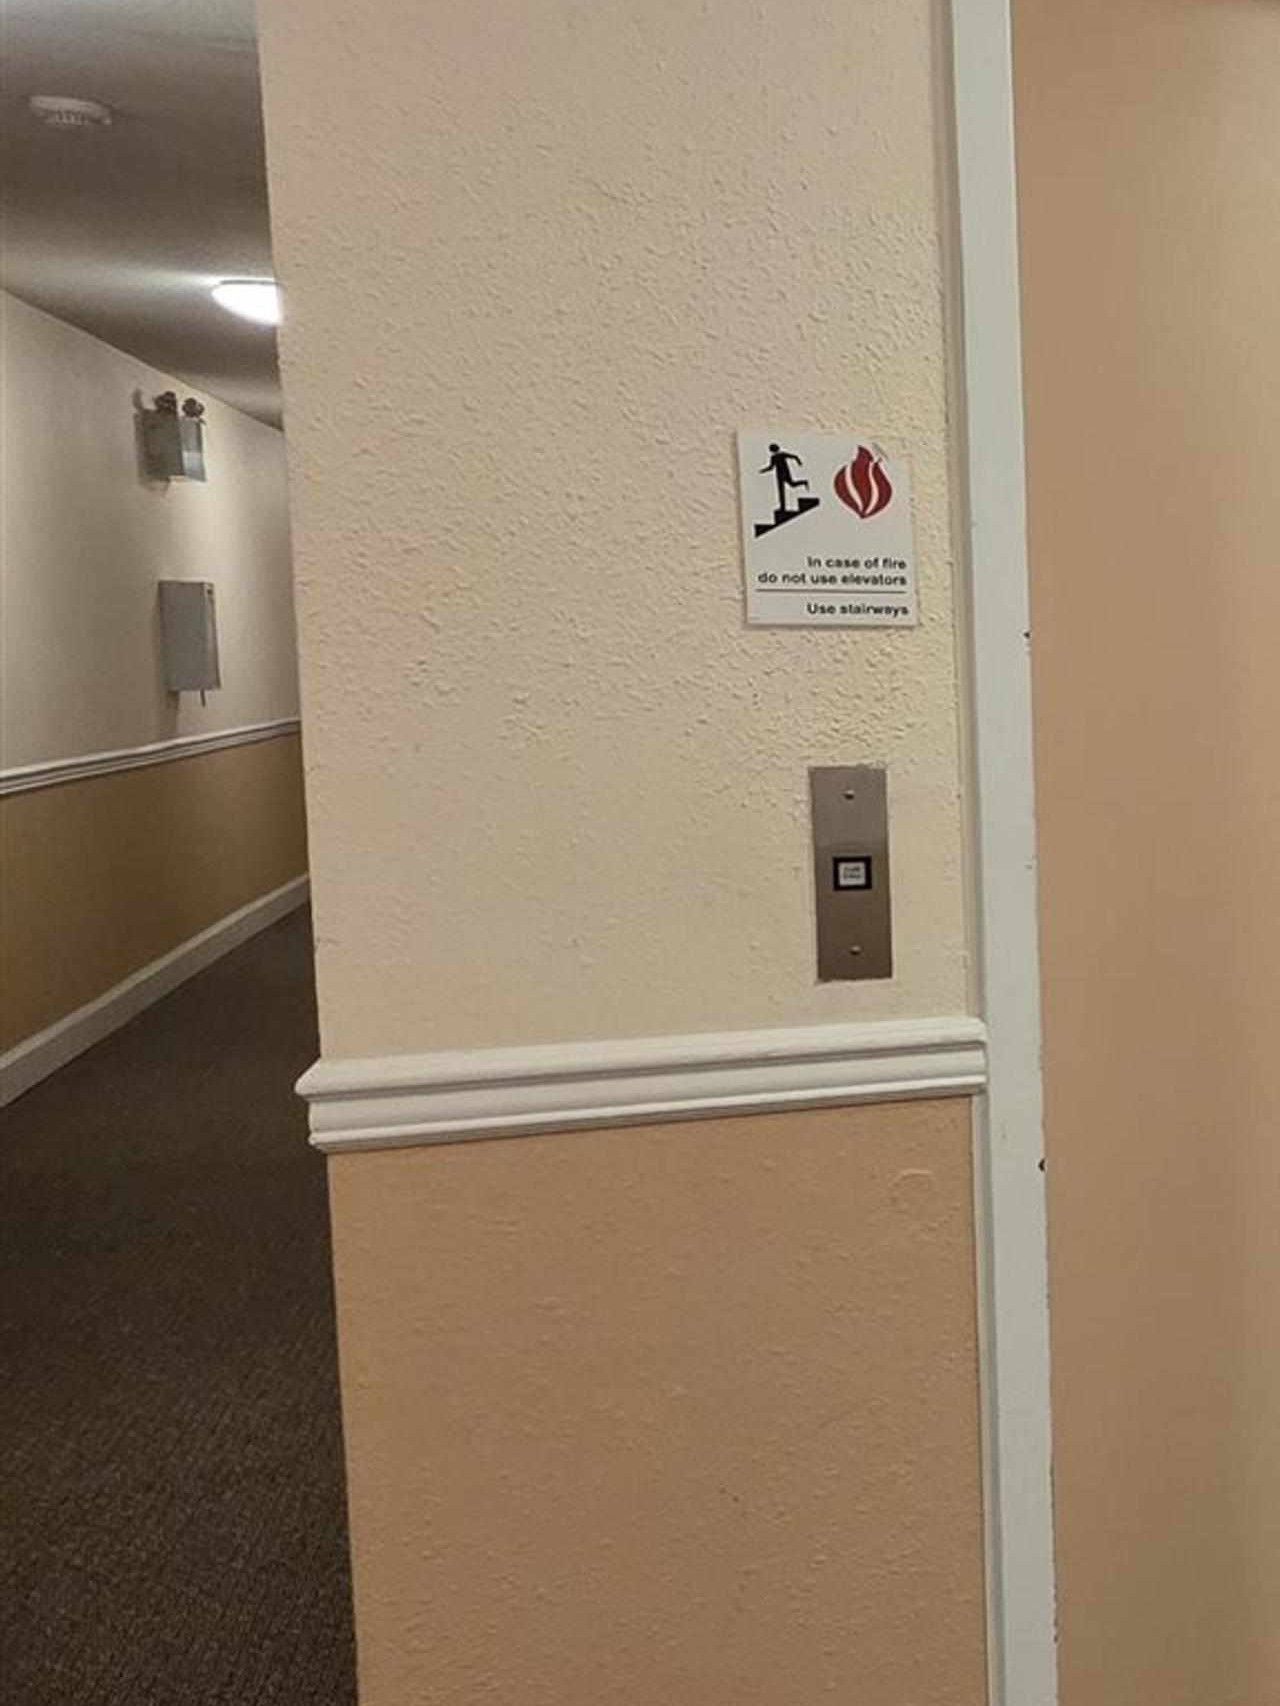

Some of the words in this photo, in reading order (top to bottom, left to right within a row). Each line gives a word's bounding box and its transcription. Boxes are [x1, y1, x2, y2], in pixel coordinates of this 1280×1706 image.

[806, 556, 821, 568] In
[825, 558, 861, 569] case
[864, 557, 880, 569] of
[882, 557, 907, 570] fire
[757, 572, 778, 584] do
[782, 572, 806, 584] not
[810, 574, 837, 585] use
[841, 573, 907, 586] elevators
[806, 602, 836, 615] Use
[839, 603, 909, 617] stairways
